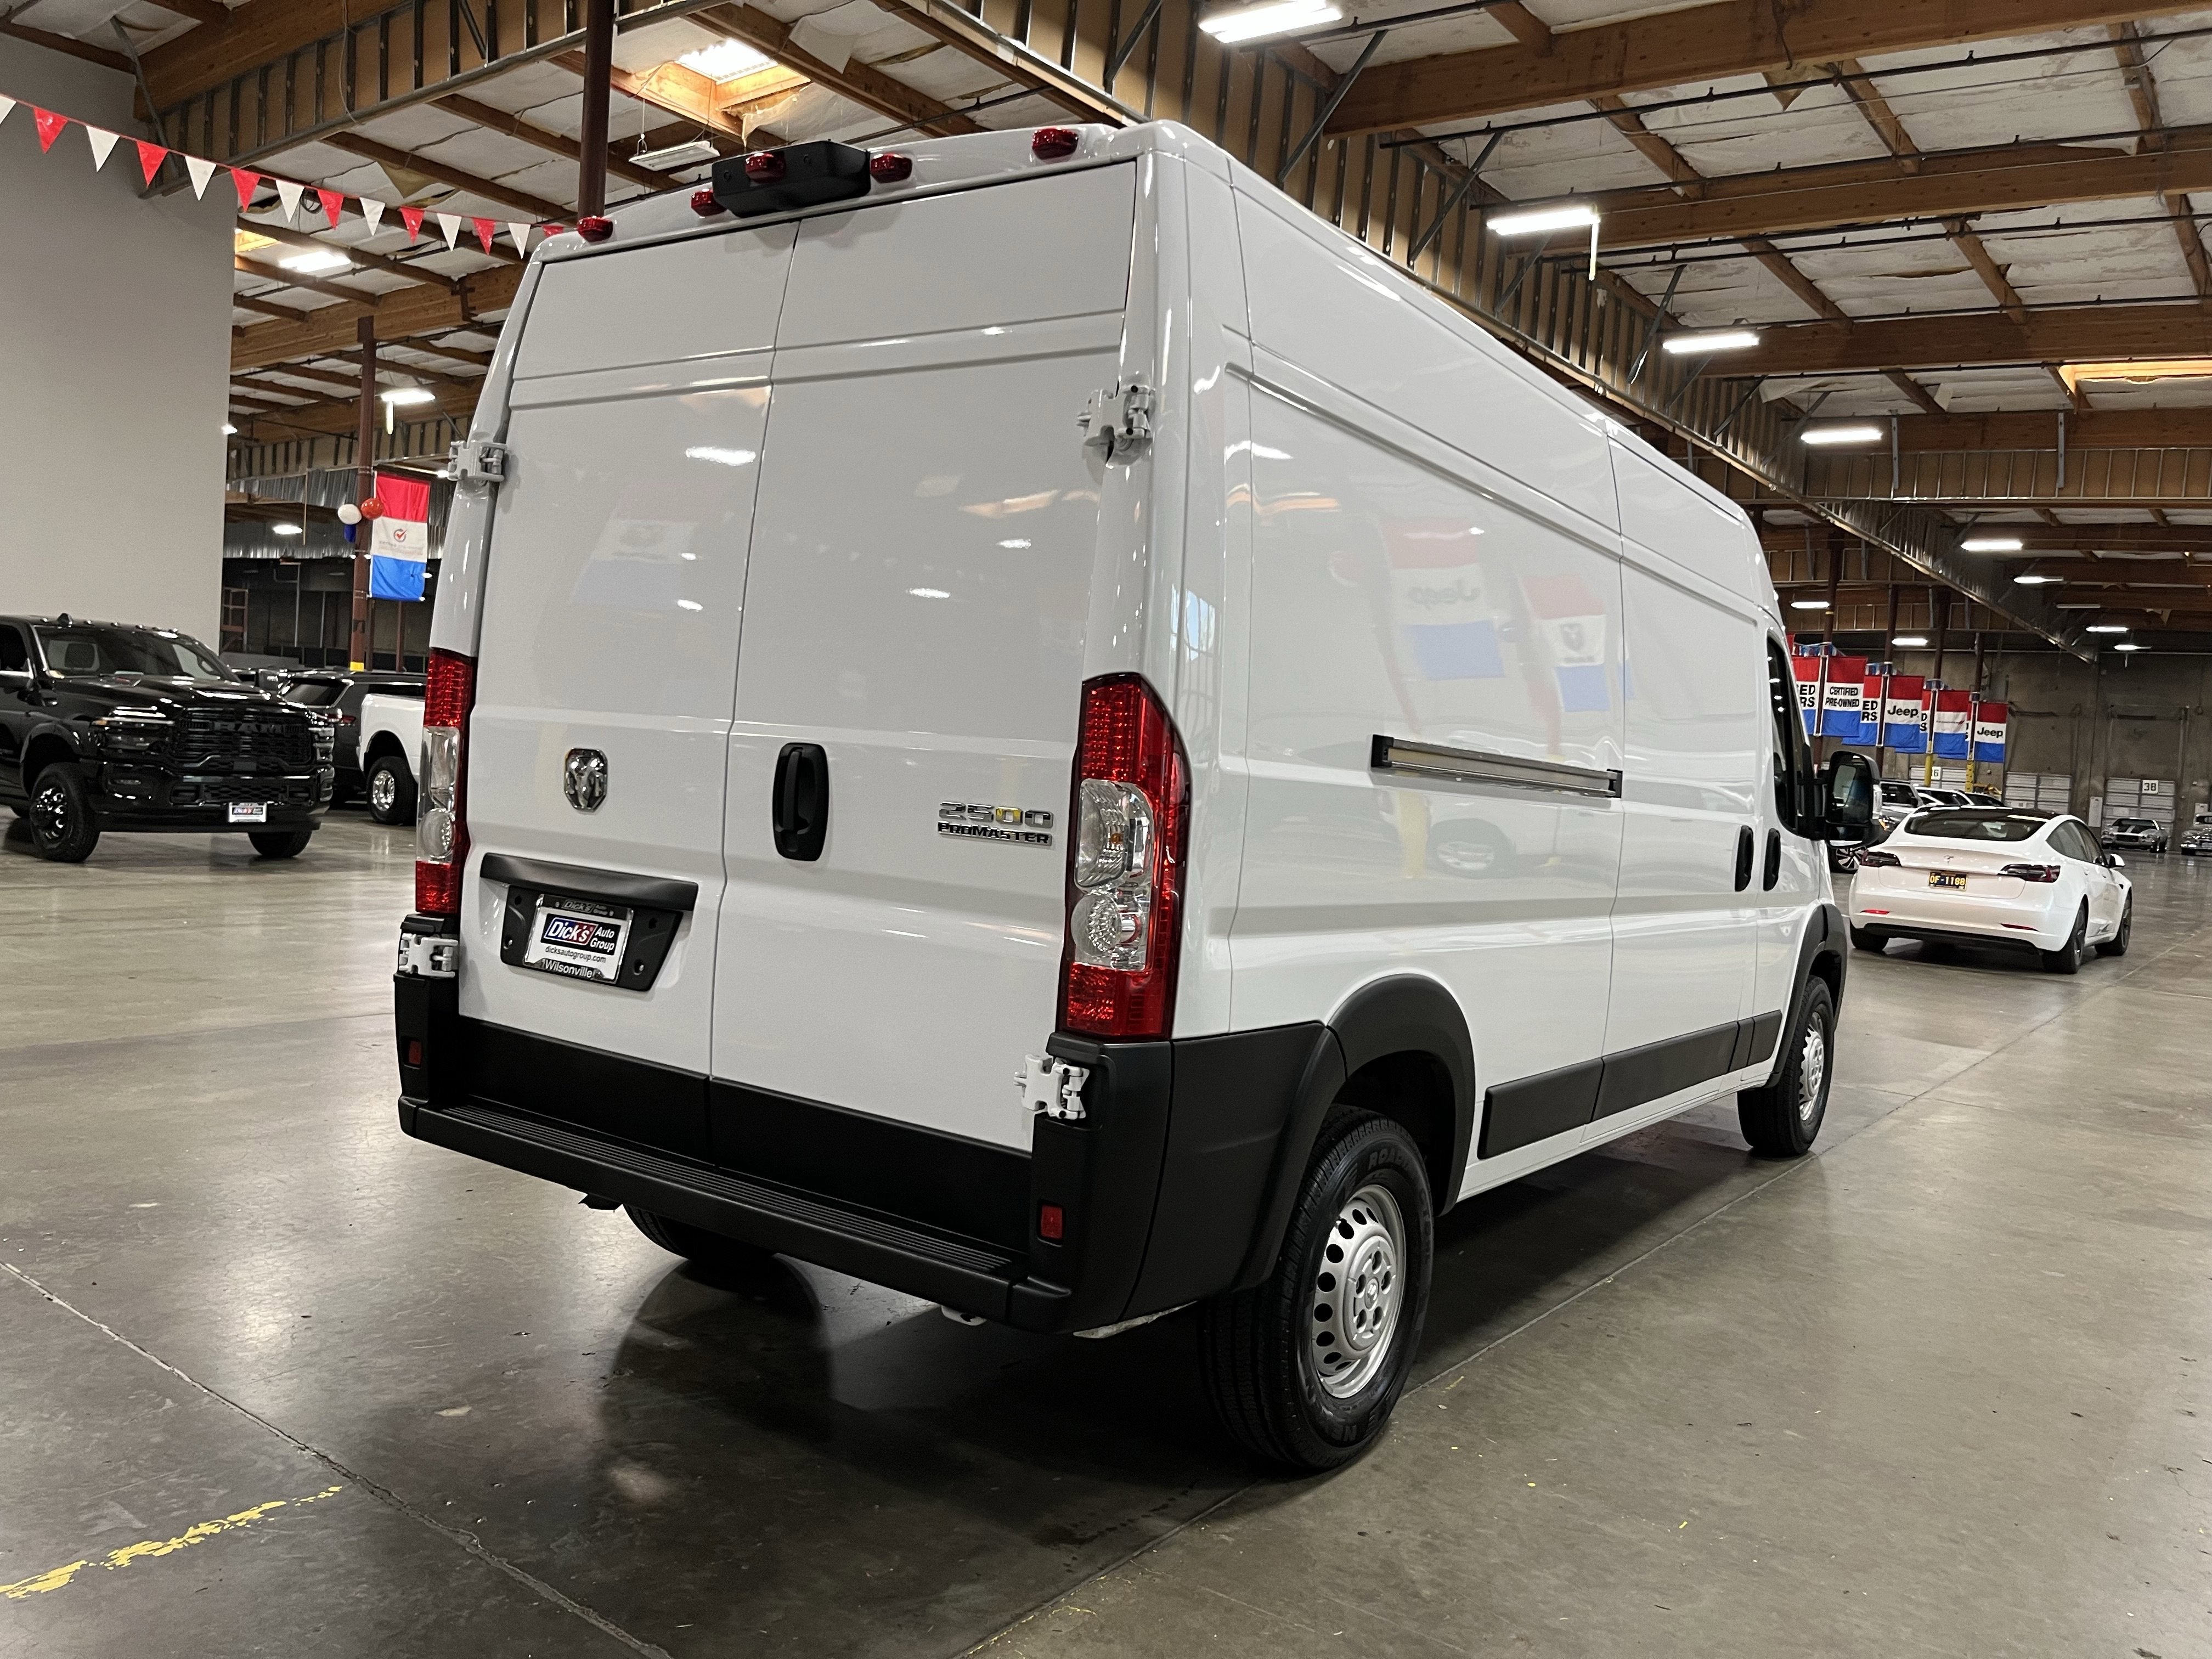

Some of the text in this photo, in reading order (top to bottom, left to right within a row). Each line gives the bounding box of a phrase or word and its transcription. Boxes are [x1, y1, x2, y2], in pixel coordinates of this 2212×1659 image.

[1799, 685, 1816, 696] ED
[1829, 686, 1859, 696] CERTIFIED
[1799, 696, 1815, 708] RS
[1825, 697, 1860, 708] PRE-OWNED
[1862, 701, 1878, 710] ED
[1861, 712, 1878, 721] RS
[1887, 705, 1919, 718] Jeep
[1977, 727, 2004, 738] Jeep
[939, 801, 1054, 829] 2500
[548, 921, 590, 943] Dick's
[595, 927, 615, 938] Auto
[590, 937, 615, 953] Group
[545, 945, 607, 963] dicksautogroup.com
[545, 959, 593, 978] Wilsonville
